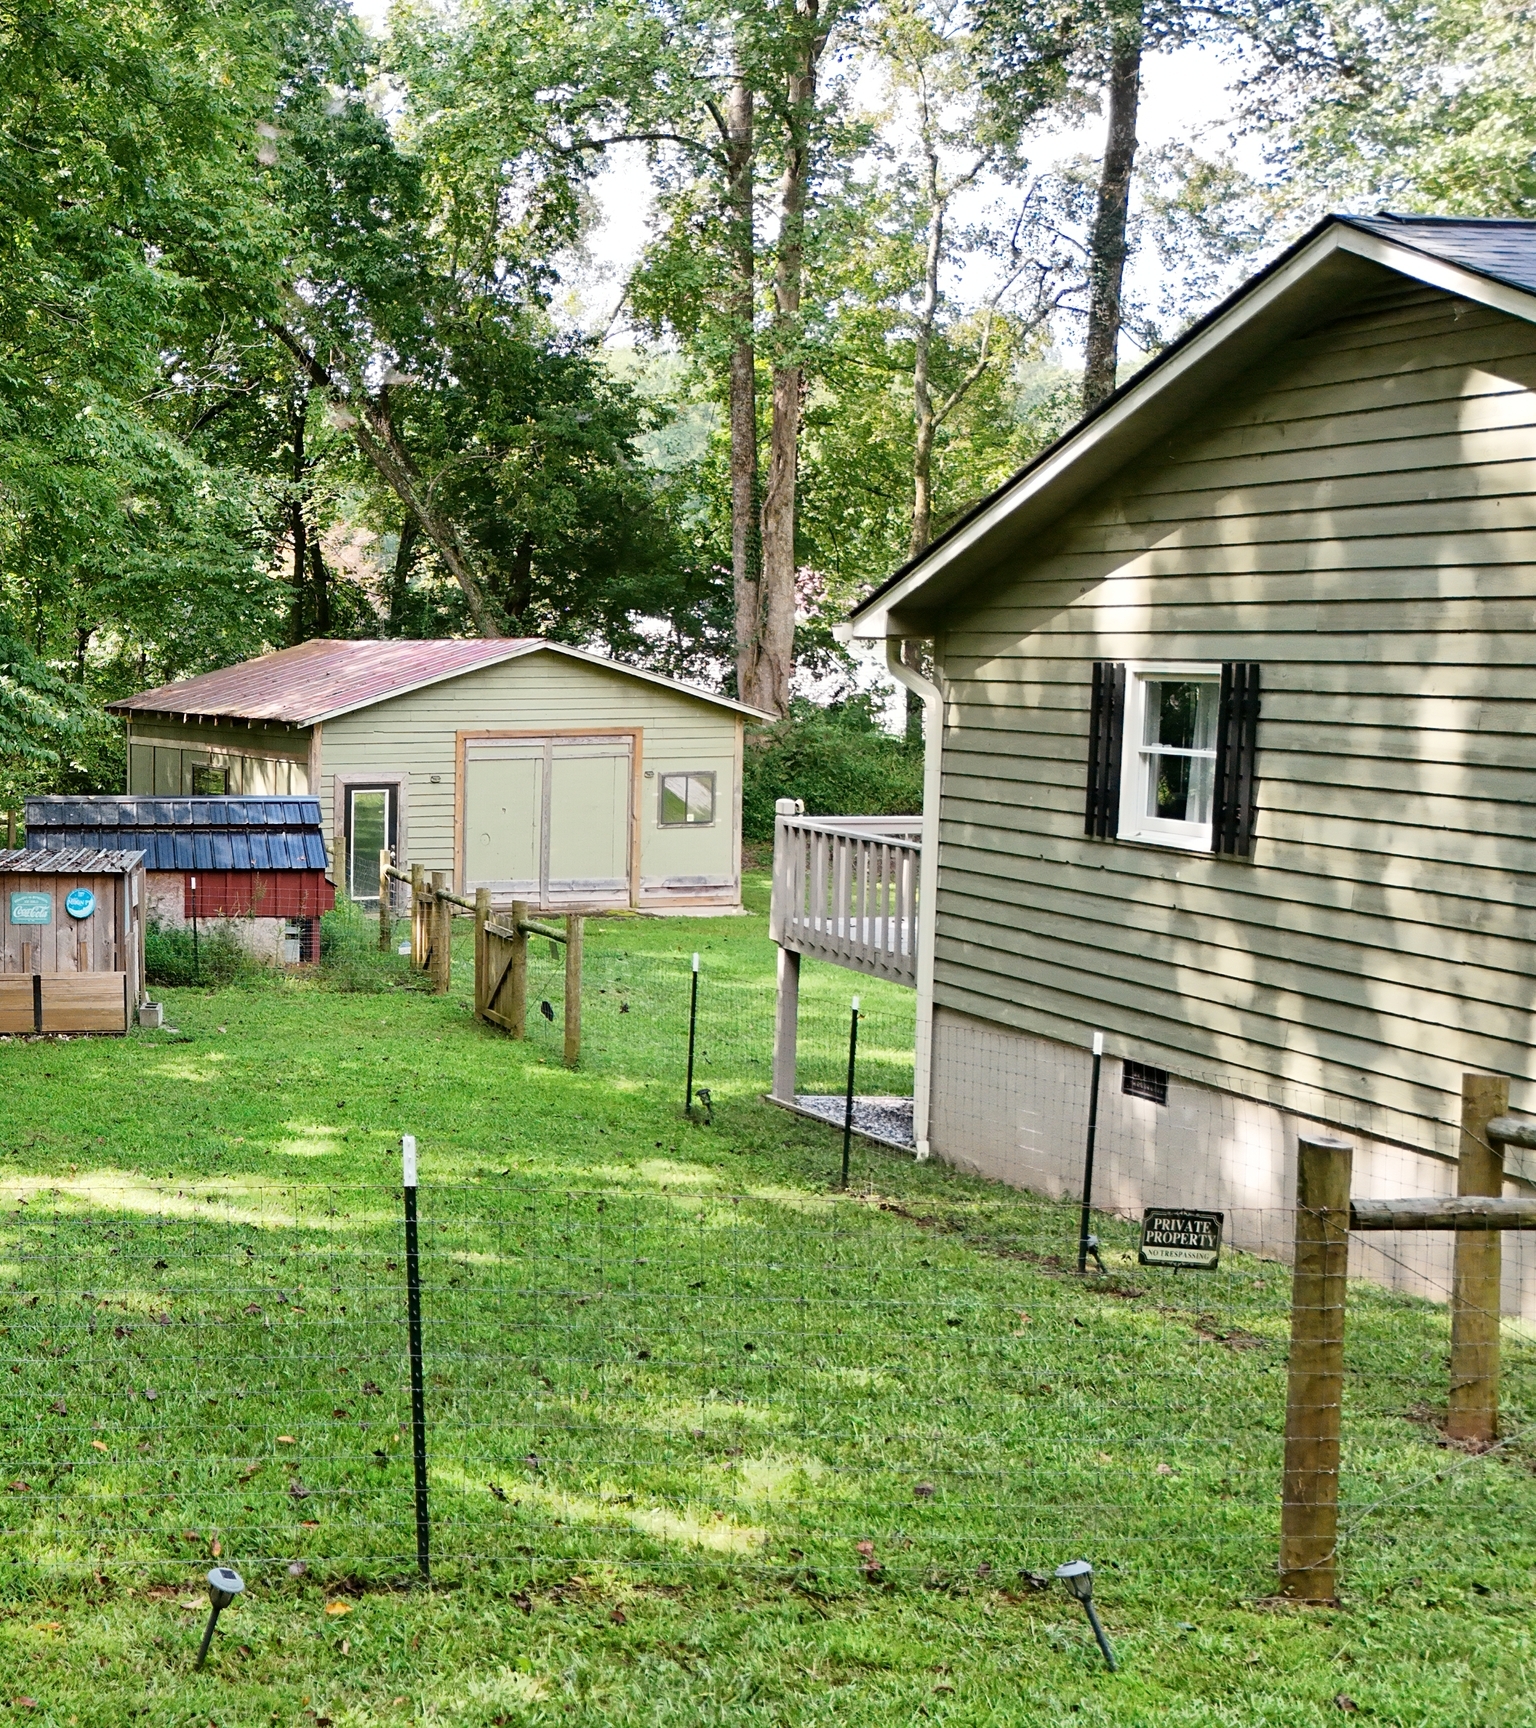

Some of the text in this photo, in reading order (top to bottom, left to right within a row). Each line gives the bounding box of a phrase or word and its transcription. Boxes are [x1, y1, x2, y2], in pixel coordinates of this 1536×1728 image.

[1154, 1218, 1211, 1234] PRIVATE
[1146, 1230, 1217, 1247] PROPERTY
[1160, 1250, 1210, 1260] TRESPASSING
